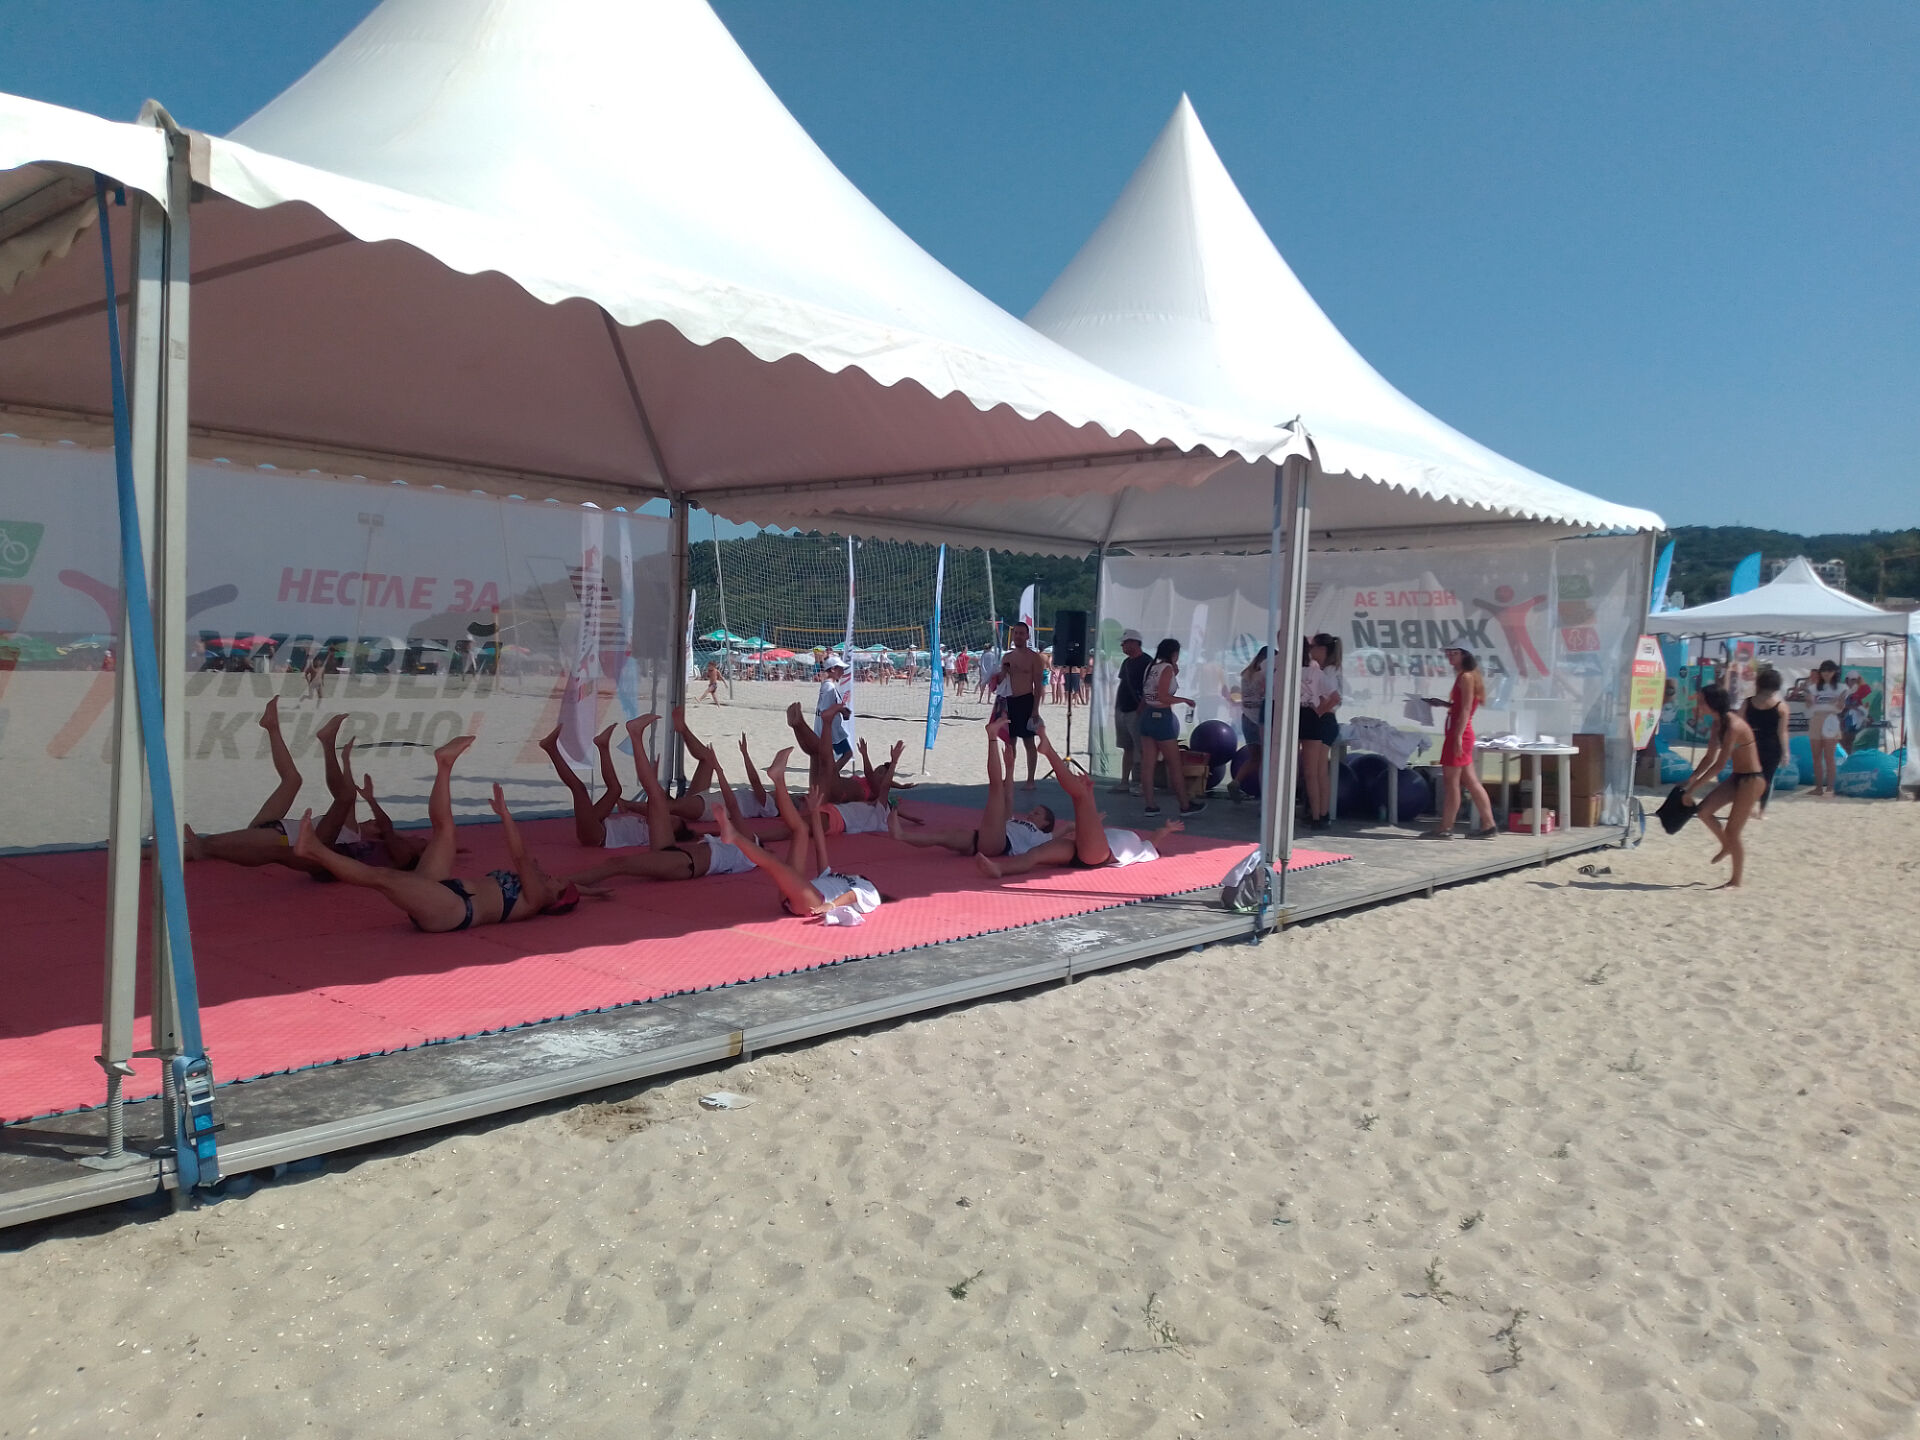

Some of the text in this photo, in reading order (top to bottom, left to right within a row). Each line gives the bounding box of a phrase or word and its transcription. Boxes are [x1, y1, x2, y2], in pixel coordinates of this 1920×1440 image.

[277, 567, 500, 613] НЕСТЛЕ ЗА
[184, 621, 504, 699] ЖИВЕЙ
